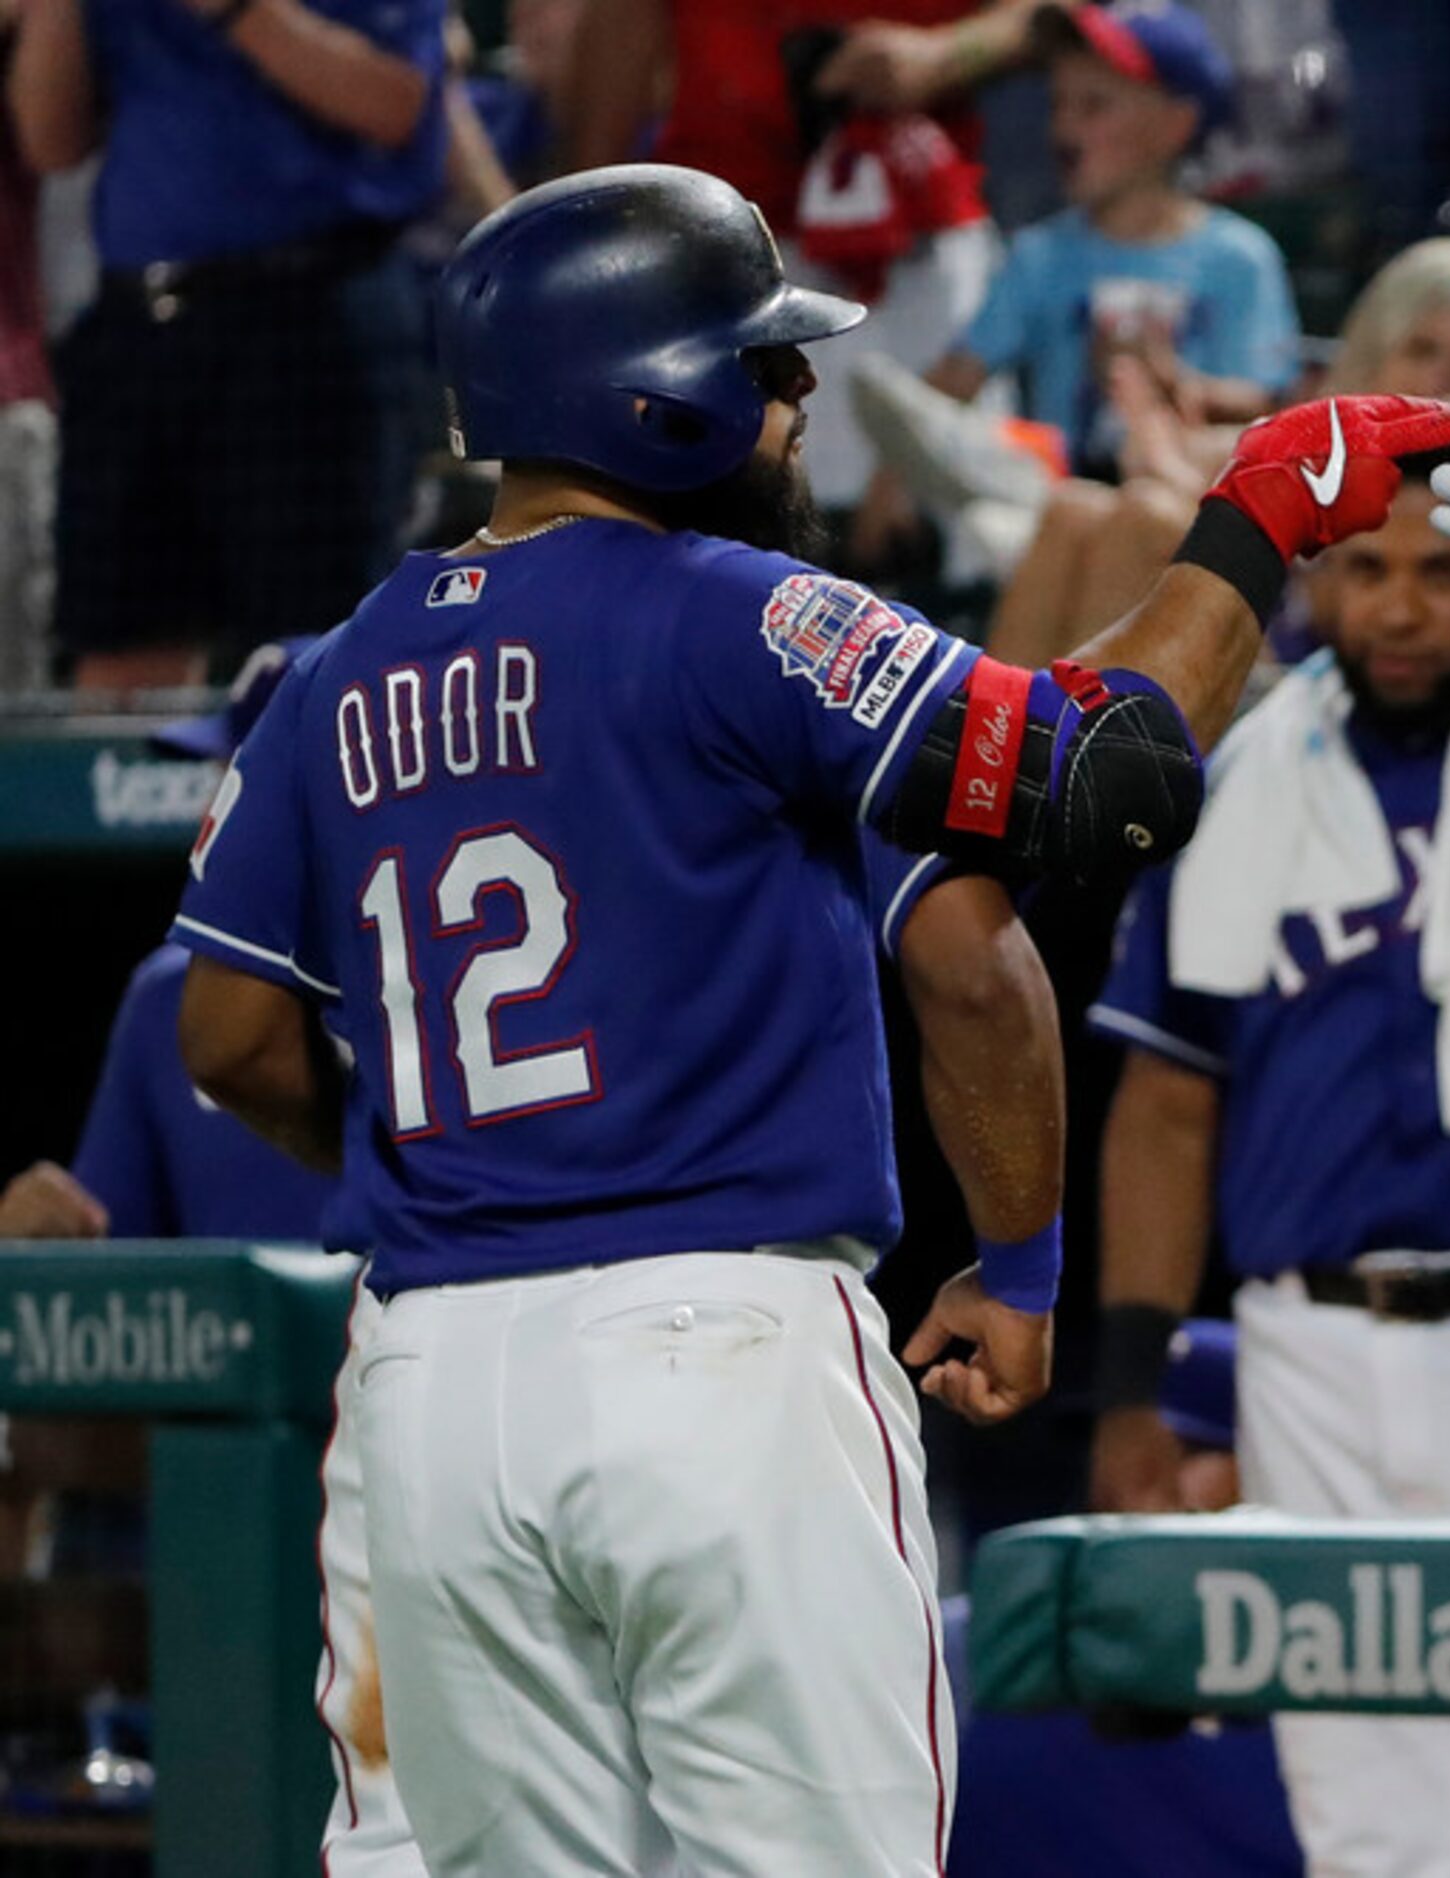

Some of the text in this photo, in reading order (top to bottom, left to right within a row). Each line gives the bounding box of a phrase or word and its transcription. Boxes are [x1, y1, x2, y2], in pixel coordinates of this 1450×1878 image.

[333, 640, 543, 815] ODOR
[860, 677, 897, 720] MLB
[966, 702, 1012, 811] 12 Odor
[358, 822, 603, 1143] 12
[14, 1289, 226, 1385] Mobile
